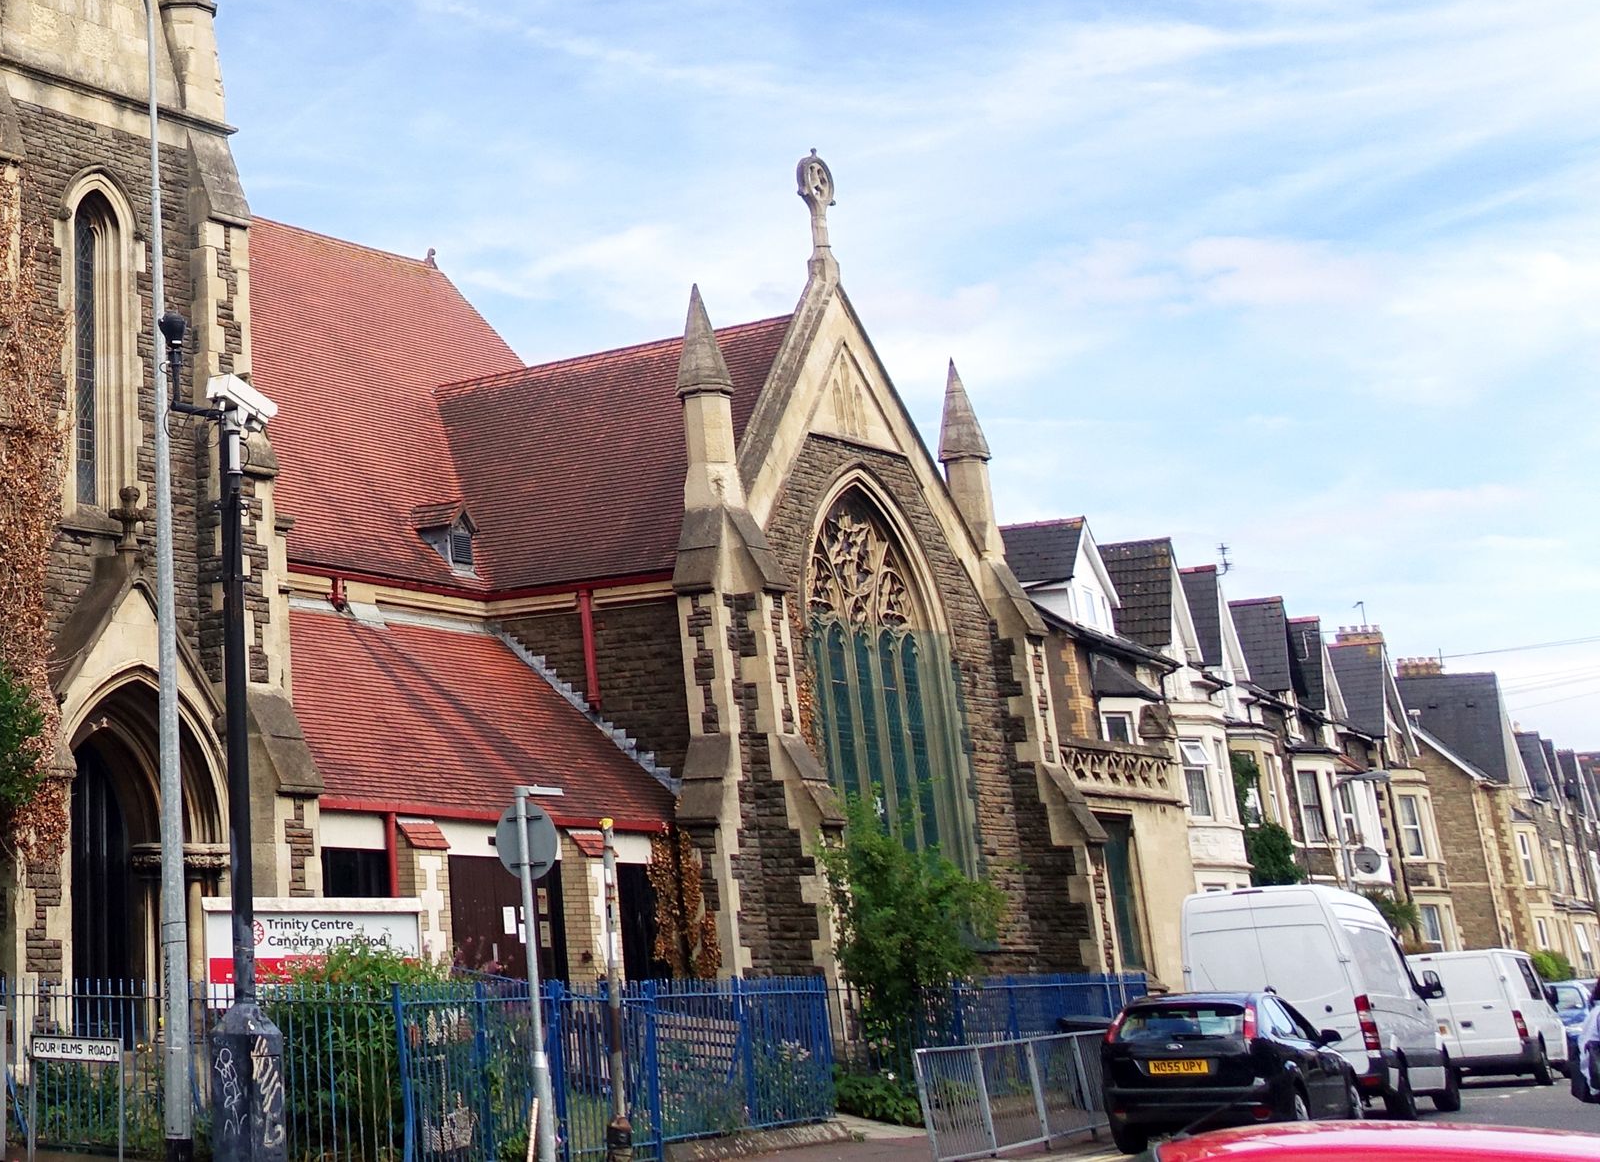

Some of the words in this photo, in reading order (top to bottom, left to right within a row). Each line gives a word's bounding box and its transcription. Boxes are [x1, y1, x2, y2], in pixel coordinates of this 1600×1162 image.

[267, 918, 309, 932] Trinity
[311, 918, 354, 930] Centre
[267, 935, 324, 947] Canolfan
[326, 937, 334, 948] y
[34, 1042, 56, 1053] FOUR
[61, 1043, 83, 1054] ELMS
[88, 1044, 112, 1056] ROAD
[1182, 1061, 1202, 1072] UPY
